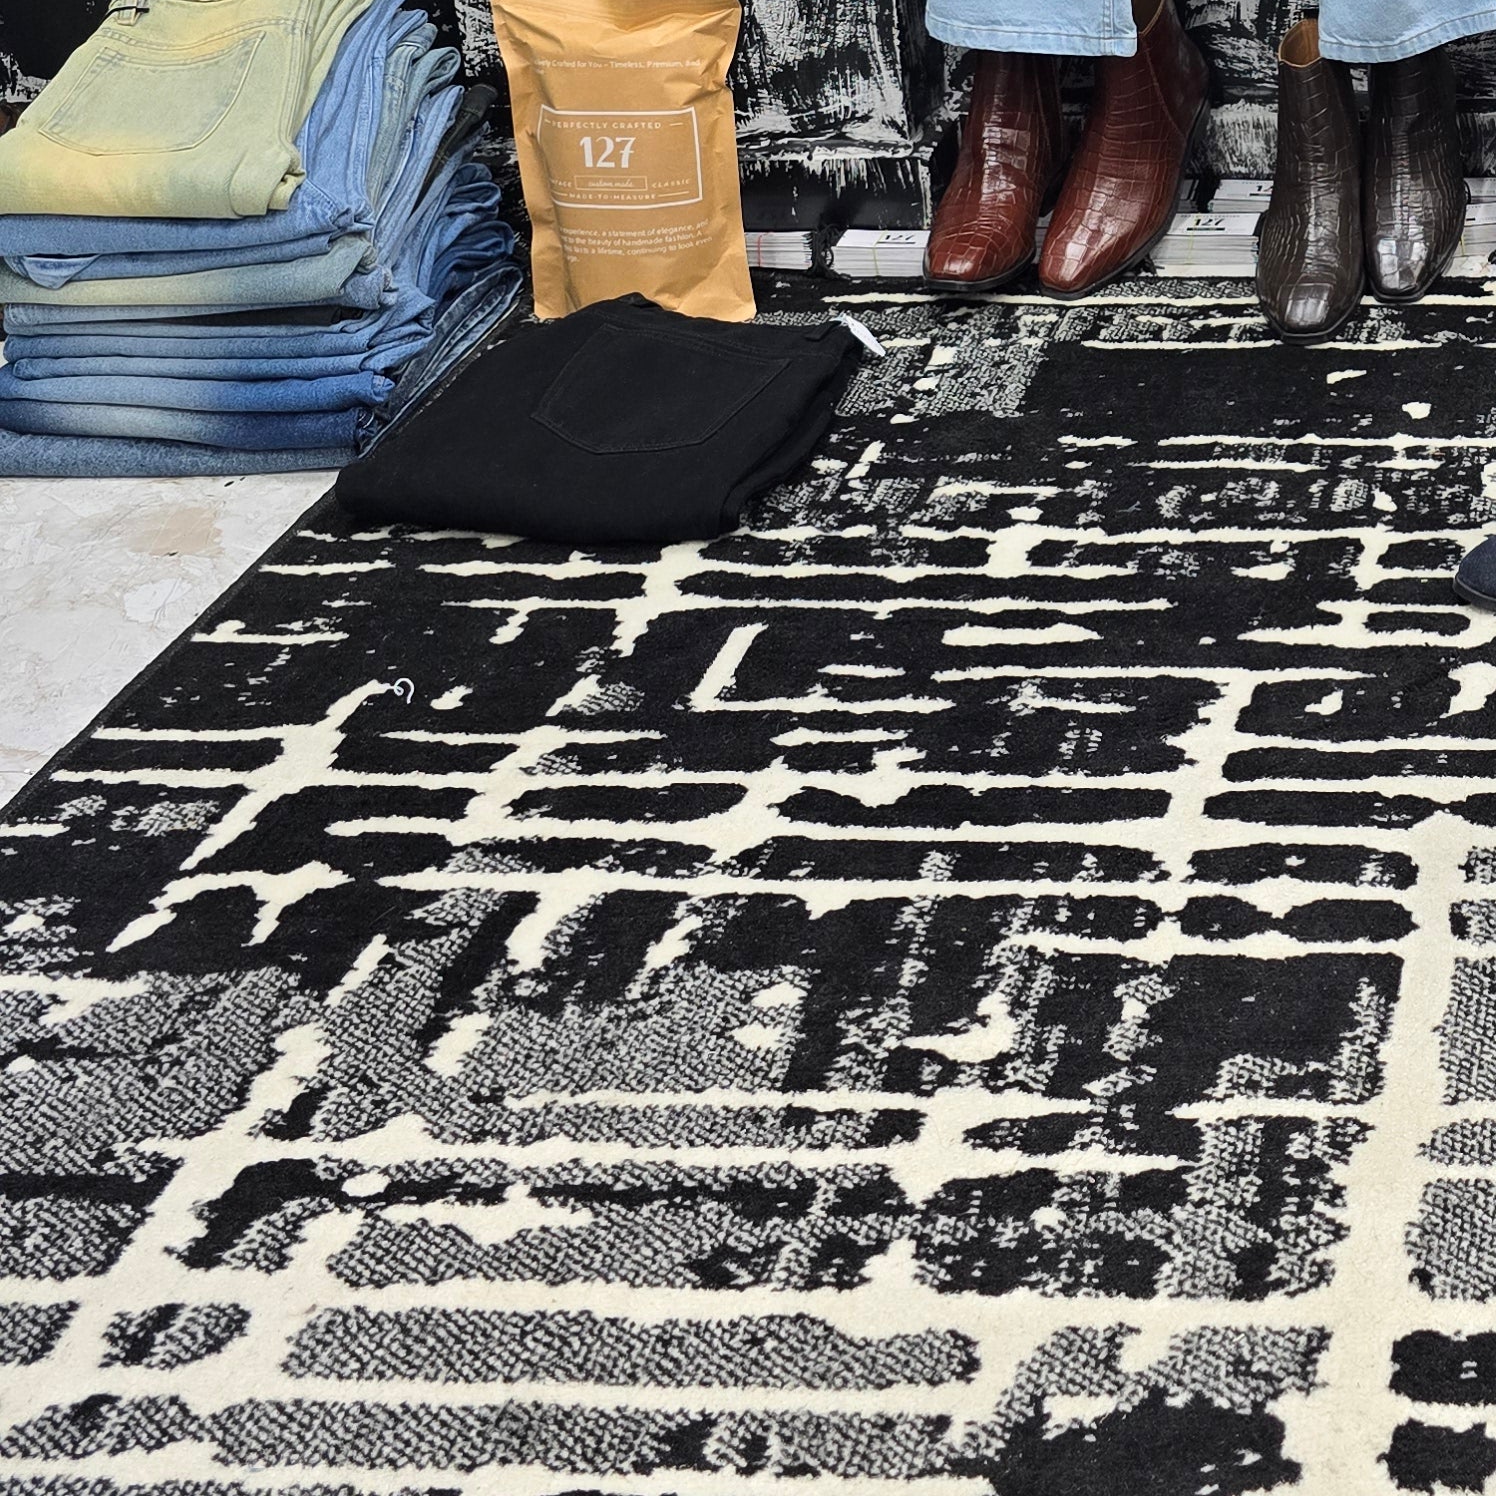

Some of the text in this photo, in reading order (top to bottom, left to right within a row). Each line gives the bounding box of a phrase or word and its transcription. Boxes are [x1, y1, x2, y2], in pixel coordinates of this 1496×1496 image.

[552, 120, 608, 129] PERFECTLY
[579, 136, 637, 168] 127
[652, 178, 690, 188] CLASSIC
[657, 224, 694, 234] elegance,
[588, 238, 612, 246] beauty
[622, 238, 663, 246] handmade
[627, 246, 668, 256] continuing
[678, 242, 694, 250] look
[696, 236, 713, 246] even
